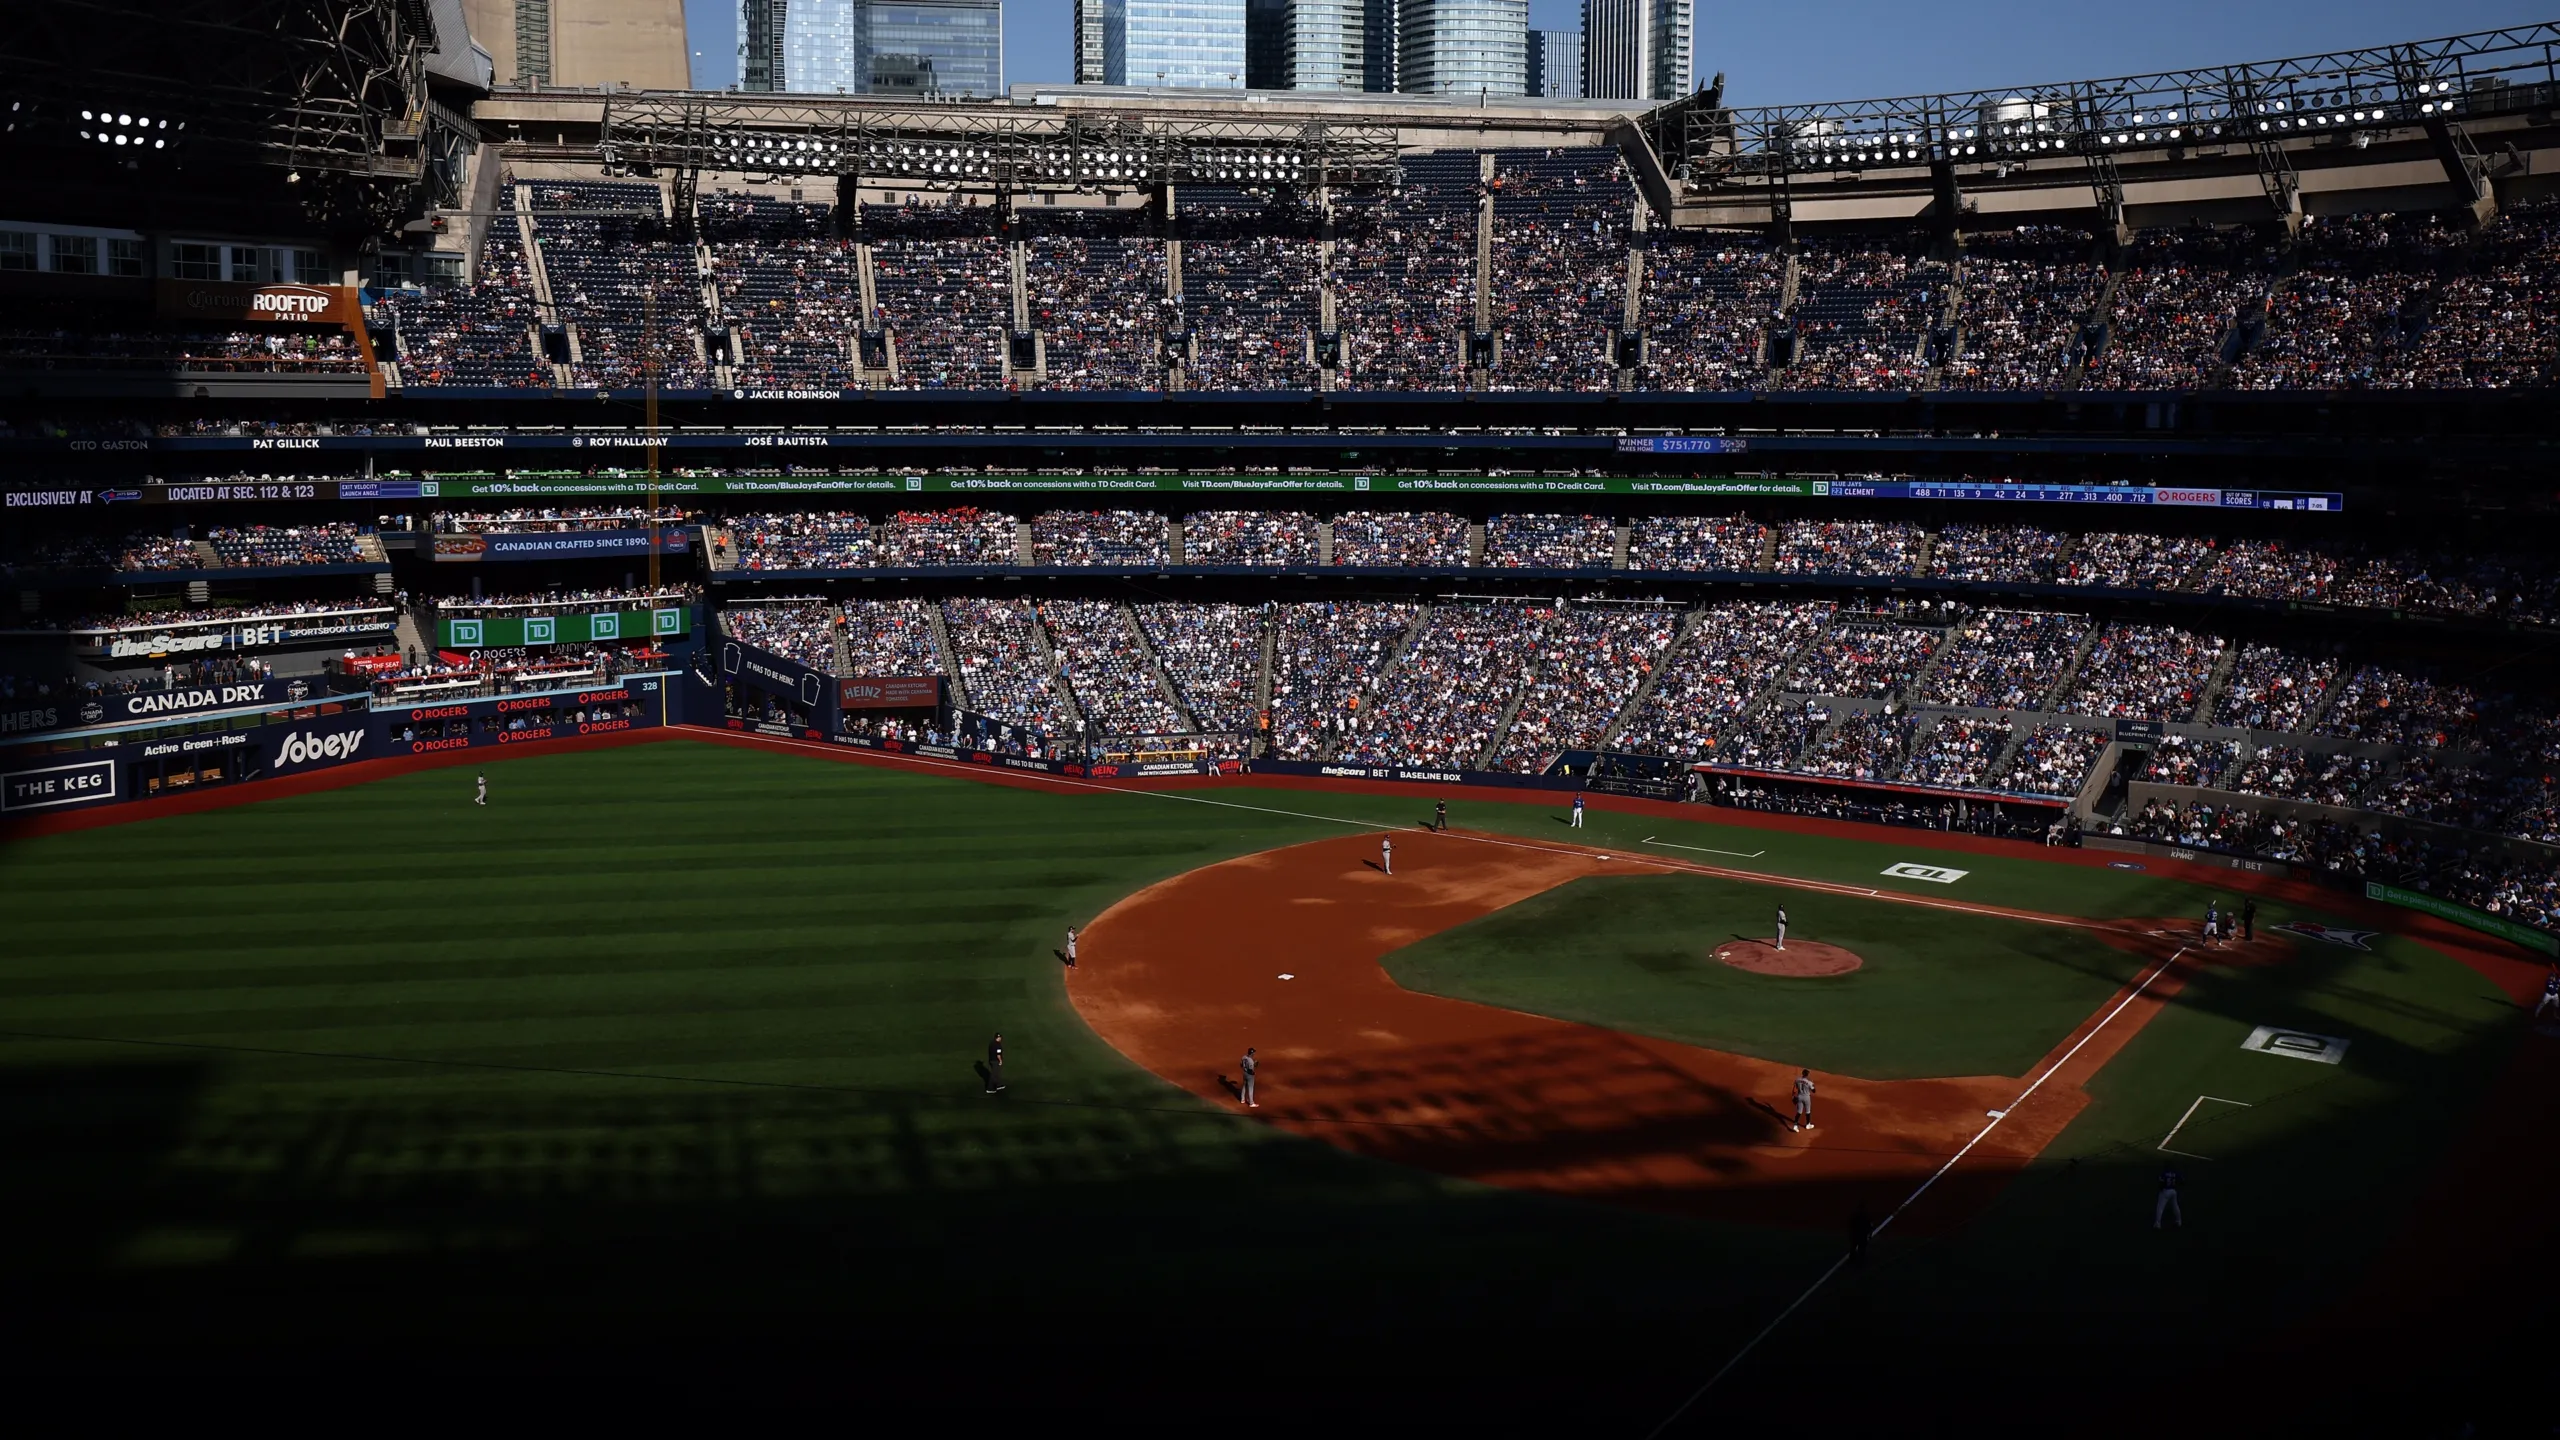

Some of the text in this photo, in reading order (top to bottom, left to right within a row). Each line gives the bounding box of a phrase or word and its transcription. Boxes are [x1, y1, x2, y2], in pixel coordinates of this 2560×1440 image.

[187, 288, 249, 310] Corona
[253, 294, 329, 313] ROOFTOP
[275, 313, 308, 322] PATIO
[749, 390, 840, 399] JACKIE ROBINSON
[70, 440, 148, 450] CITO GASTON
[253, 439, 320, 448] PAT GILLICK
[425, 438, 504, 447] PAUL BEESTON
[590, 438, 668, 446] ROY HALLADAY
[745, 436, 828, 446] JOSÉ BAUTISTA
[489, 484, 511, 492] 10%
[513, 484, 539, 492] back
[745, 482, 852, 490] TD.com/BlueJaysFanOffer
[966, 480, 985, 488] 10%
[1182, 480, 1199, 488] Visit
[1201, 480, 1302, 489] TD.com/BlueJaysFanOffer
[1304, 480, 1315, 488] for
[1650, 483, 1758, 492] TD.com/BlueJaysFanOffer
[6, 490, 92, 506] EXCLUSIVELY AT
[168, 485, 314, 501] LOCATED AT SEC. 112 & 123
[2057, 492, 2073, 500] .277
[2172, 492, 2215, 502] ROGERS
[2226, 497, 2252, 505] SCORES
[495, 537, 649, 552] CANADIAN CRAFTED SINCE 1890.
[111, 634, 223, 657] theScore
[243, 627, 283, 646] BET
[290, 626, 347, 636] SPORTSBOOK
[358, 623, 389, 632] CASINO
[484, 642, 594, 660] ROGERS LANDING
[747, 661, 795, 686] IT HAS TO BE HEINZ.
[642, 682, 658, 691] 328
[590, 689, 629, 702] ROGERS
[844, 686, 881, 699] HEINZ
[128, 689, 218, 714] CANADA
[510, 697, 551, 710] ROGERS
[425, 706, 468, 719] ROGERS
[1, 707, 58, 732] HERS
[591, 719, 629, 732] ROGERS
[511, 728, 552, 741] ROGERS
[144, 734, 246, 756] Active Green+Ross
[274, 729, 364, 768] Sobeys
[426, 737, 469, 750] ROGERS
[884, 741, 904, 751] HEINZ
[972, 752, 992, 763] HEINZ
[1011, 759, 1020, 767] HAS
[1034, 762, 1048, 770] HEINZ.
[1063, 764, 1085, 775] HEINZ
[1091, 765, 1119, 776] HEINZ
[1322, 766, 1461, 781] theScore BET BASELINE BOX
[14, 774, 101, 797] THE KEG
[2245, 862, 2262, 871] BET
[2387, 890, 2402, 900] Get
